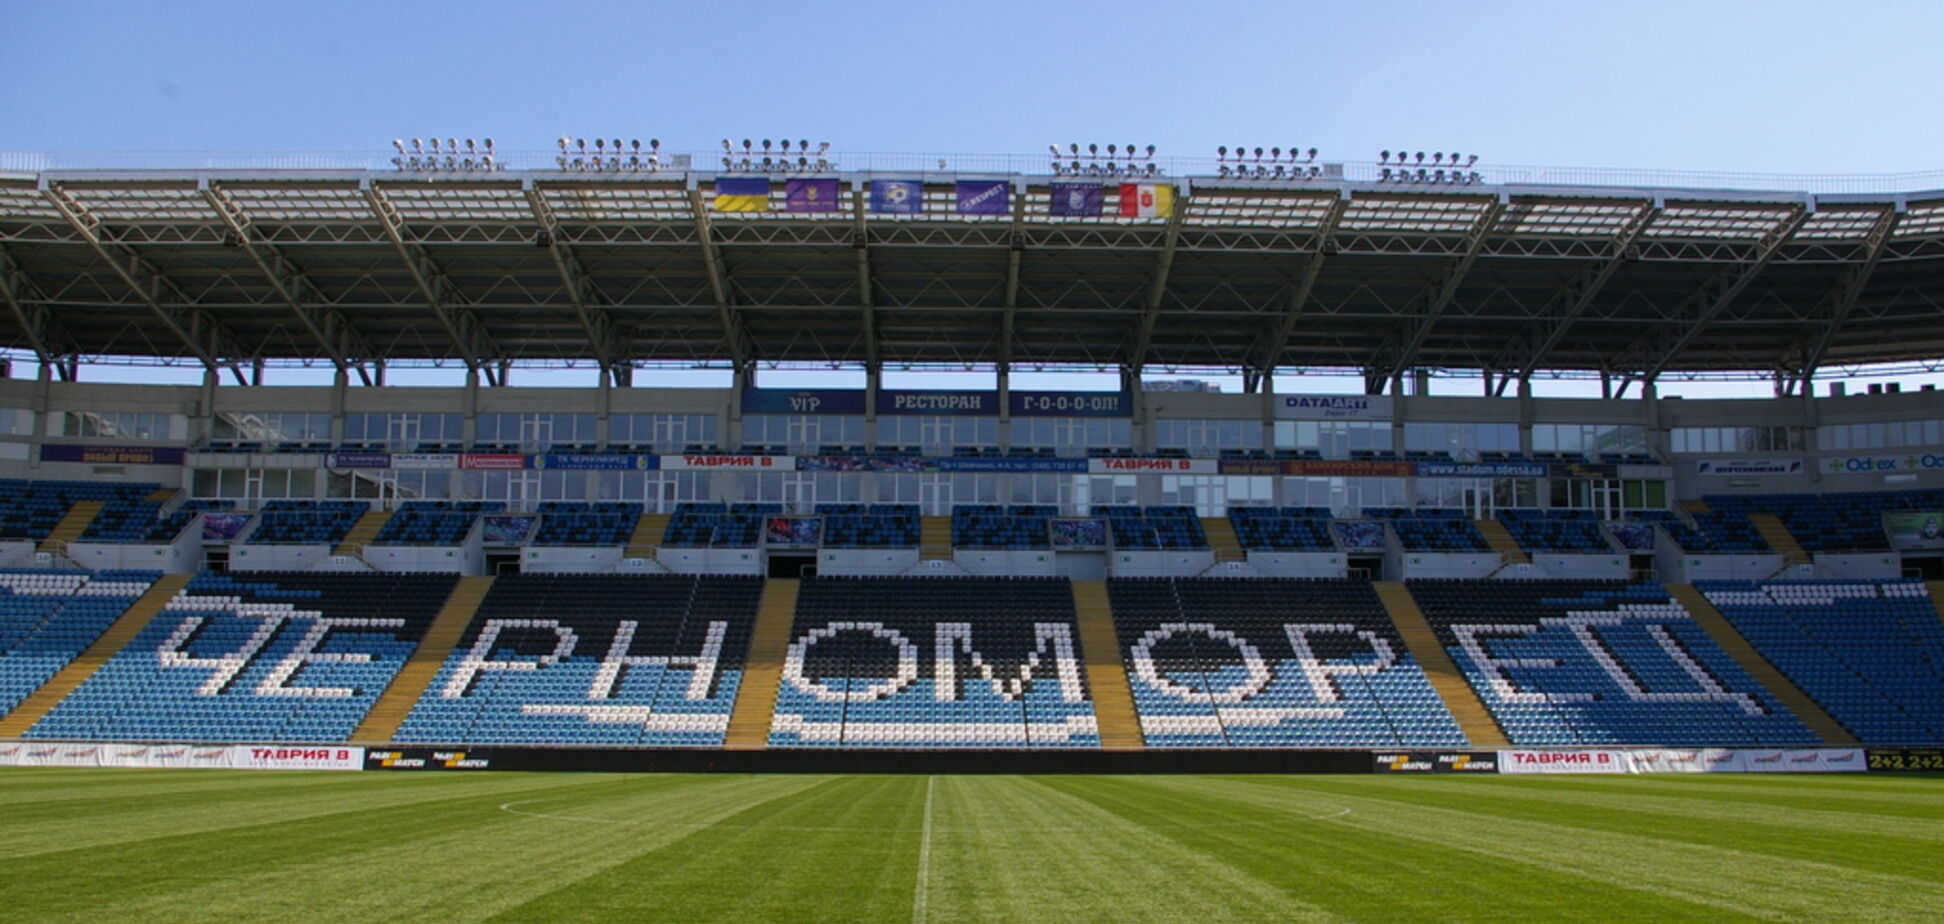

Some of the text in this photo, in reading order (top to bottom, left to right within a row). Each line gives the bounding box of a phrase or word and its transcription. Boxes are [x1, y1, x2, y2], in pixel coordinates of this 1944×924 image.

[788, 396, 821, 412] VIP
[895, 395, 981, 409] РЕСТОРАН
[1024, 396, 1118, 410] Г-О-О-О-ОЛ!
[684, 456, 772, 466] ТАВРИЯ В
[1103, 459, 1190, 469] ТАВРИЯ В
[1846, 457, 1896, 471] Odrex
[158, 615, 1768, 715] ЧЕРНОМОРЕЦ
[251, 749, 349, 760] ТАВРИЯ В
[1513, 753, 1610, 763] ТАВРИЯ В
[1402, 762, 1432, 770] MATCH
[1463, 762, 1494, 770] MATCH
[1869, 755, 1904, 769] 2+2
[1908, 755, 1944, 769] 2+2
